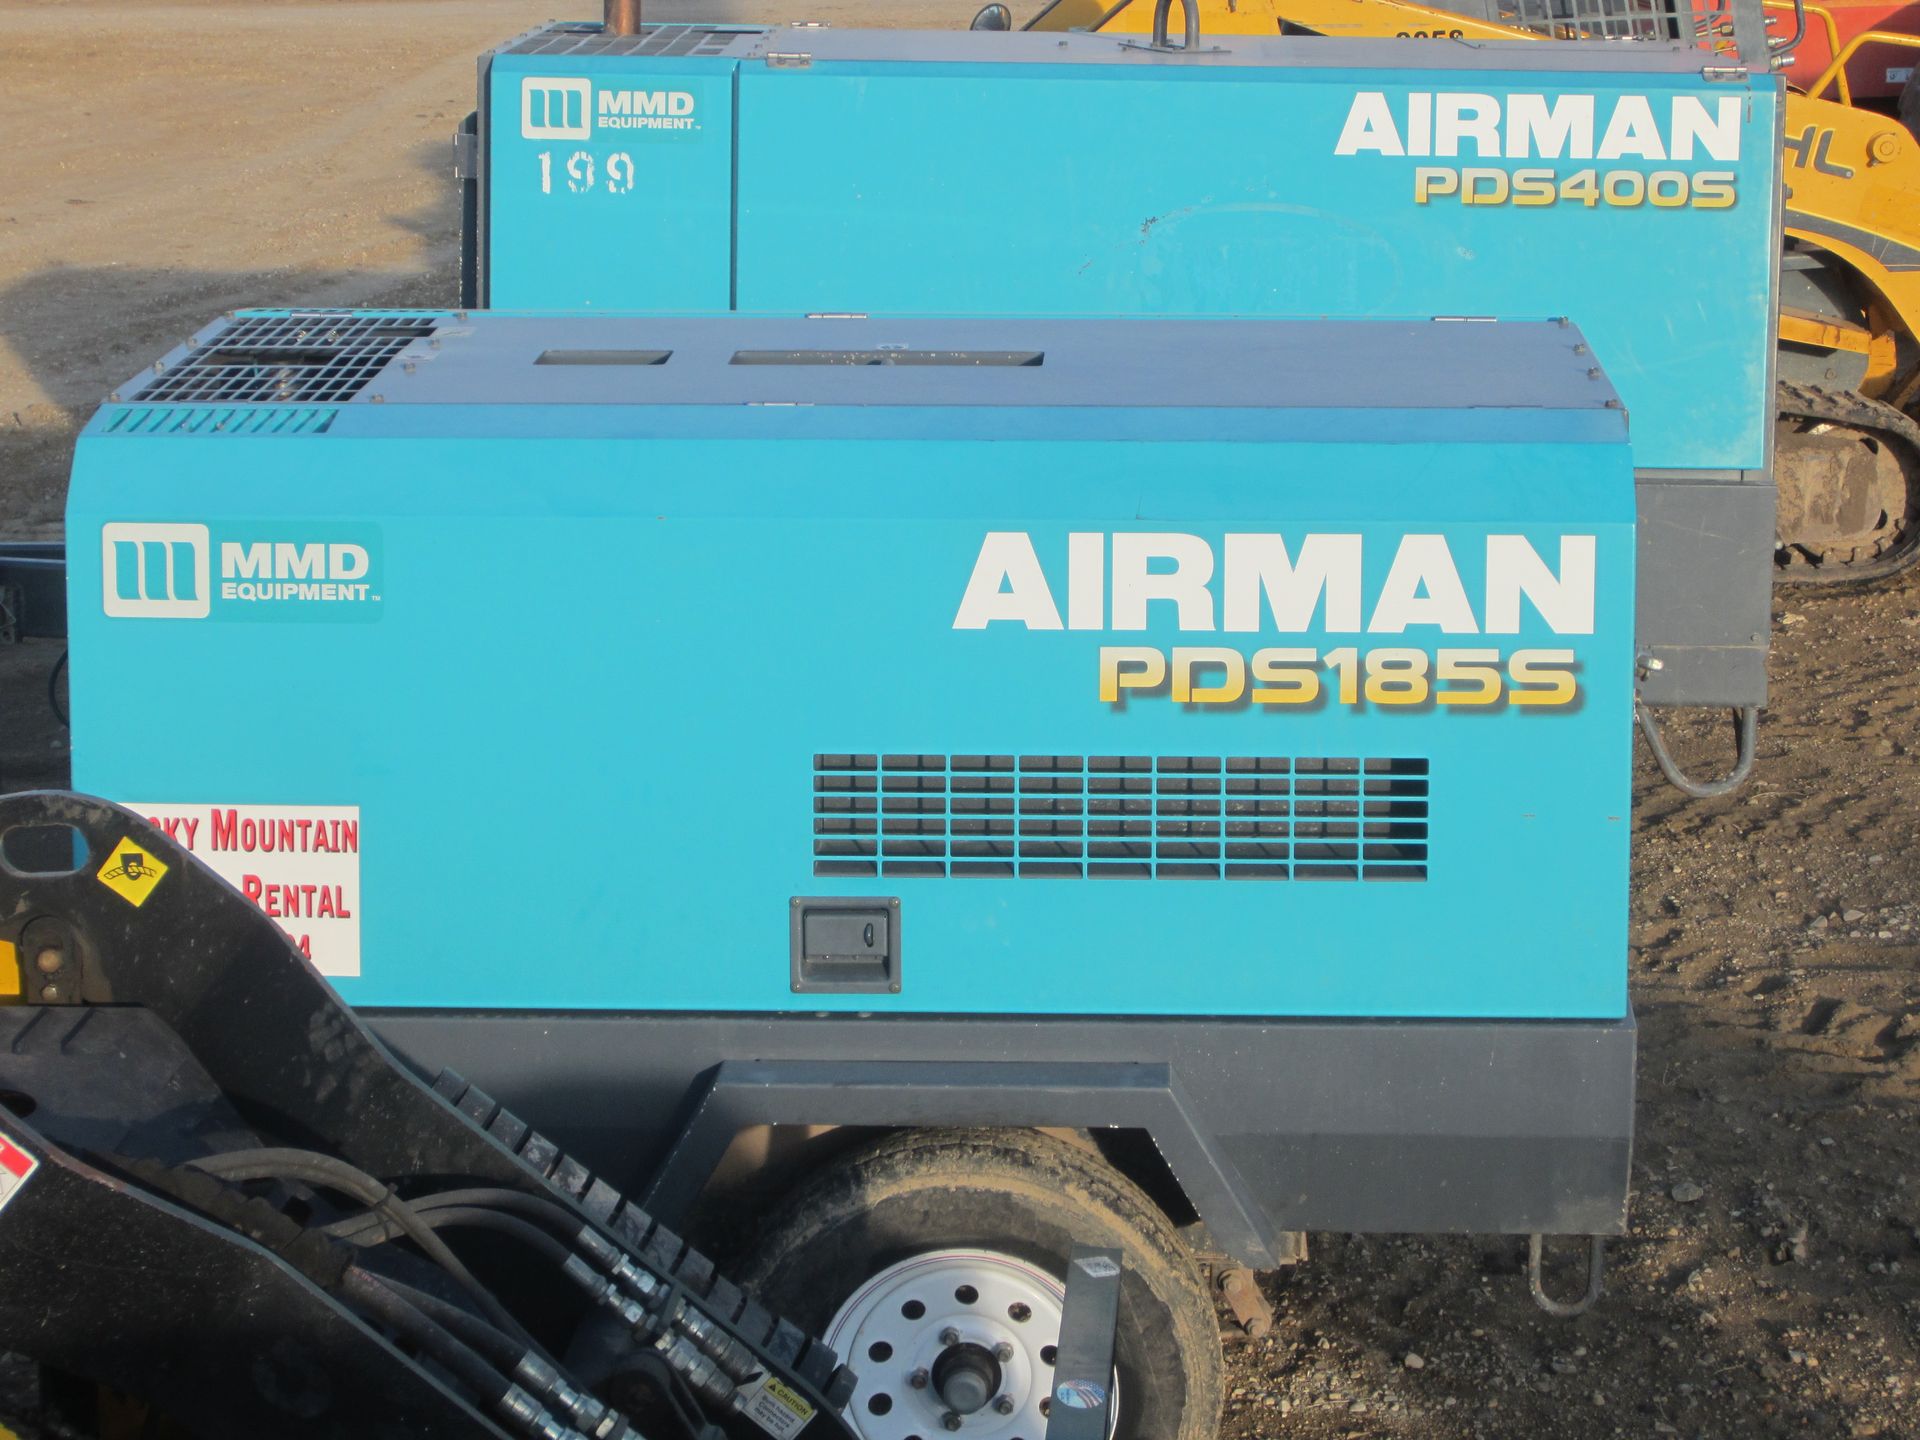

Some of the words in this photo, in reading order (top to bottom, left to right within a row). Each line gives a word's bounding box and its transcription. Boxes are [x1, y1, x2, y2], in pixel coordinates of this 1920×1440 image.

[597, 116, 695, 130] EQUIPMENT
[598, 90, 694, 116] MMD
[1333, 91, 1742, 161] AIRMAN
[538, 151, 635, 194] 199
[1415, 166, 1737, 209] PDS400S
[221, 542, 369, 580] MMD
[221, 582, 370, 602] EQUIPMENT
[952, 531, 1596, 635] AIRMAN
[1099, 646, 1579, 706] PDS185S
[211, 809, 358, 854] MOUNTAIN
[242, 874, 351, 919] RENTAL
[776, 1389, 809, 1416] CAUTION
